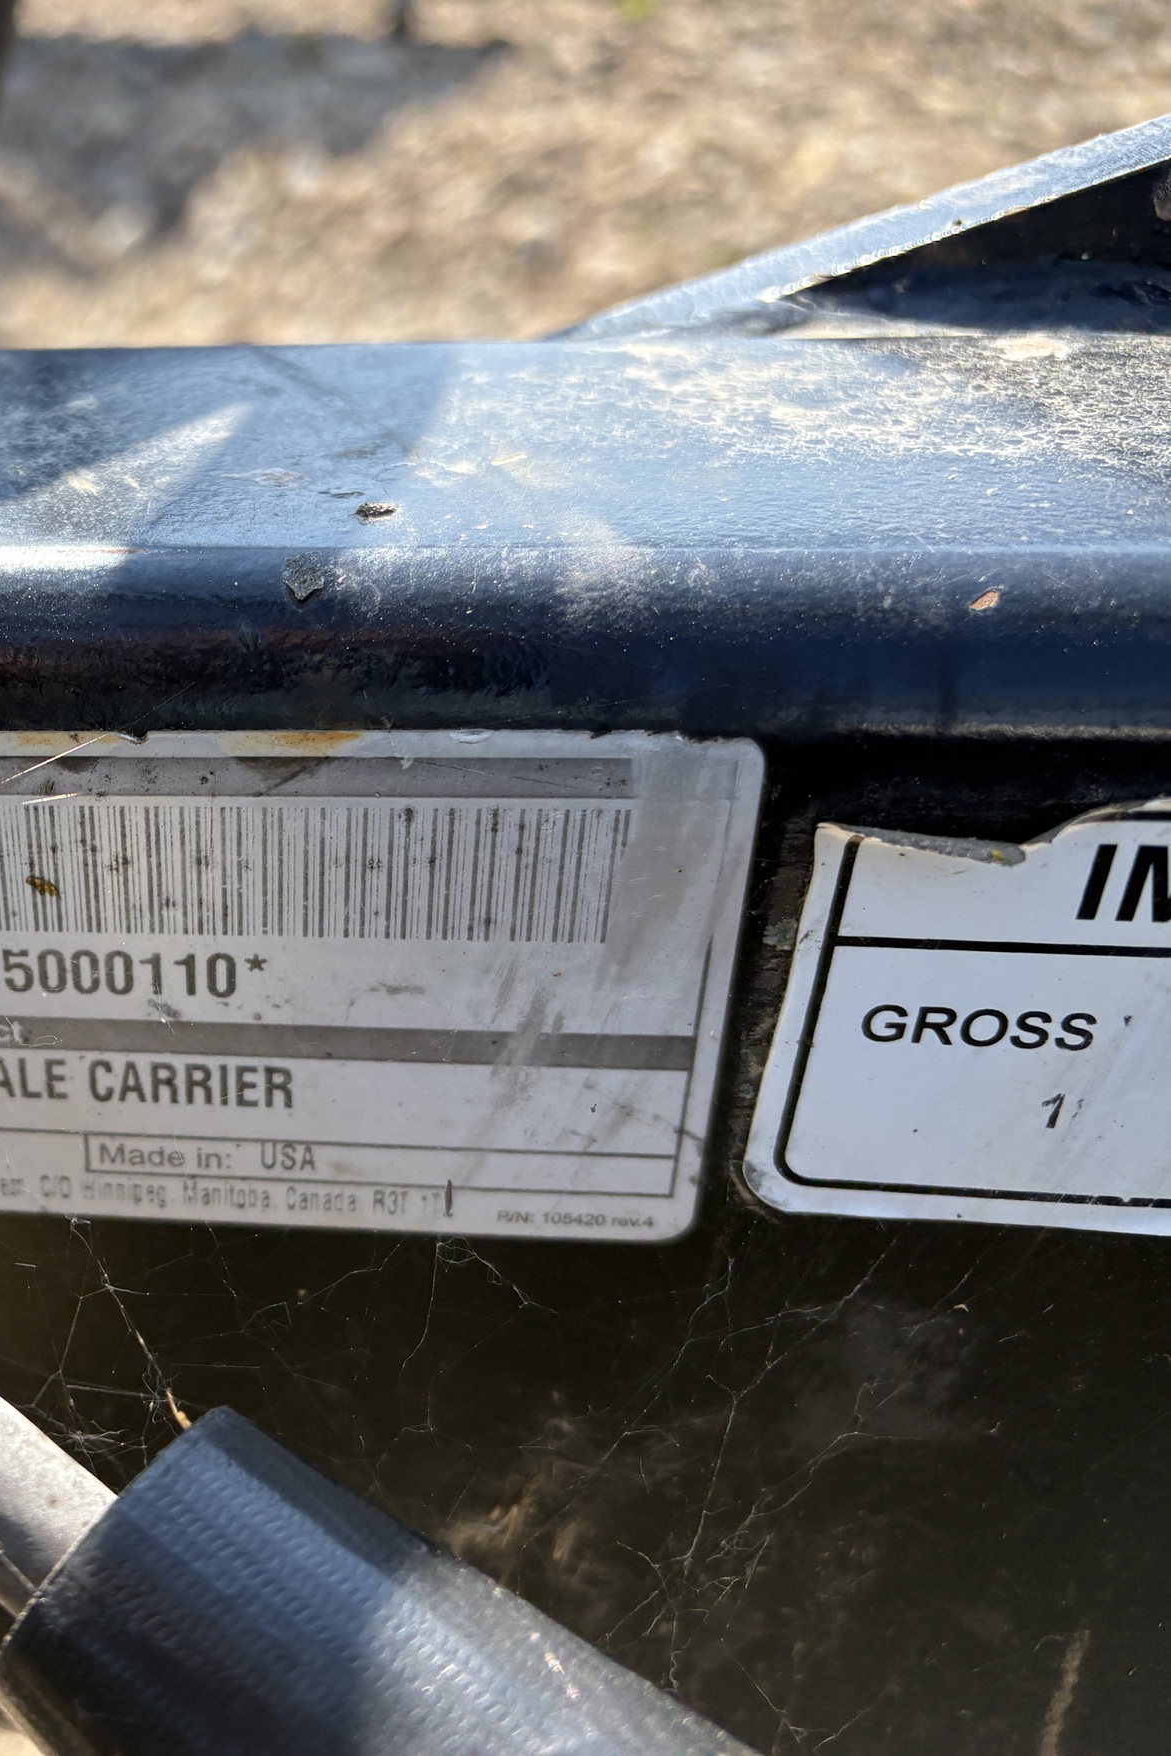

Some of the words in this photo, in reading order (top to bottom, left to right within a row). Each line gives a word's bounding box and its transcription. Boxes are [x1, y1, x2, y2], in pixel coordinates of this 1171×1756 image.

[861, 1005, 1097, 1051] GROSS
[87, 1060, 293, 1109] CARRIER
[99, 1142, 185, 1167] Made
[196, 1146, 232, 1170] in:
[259, 1142, 316, 1170] USA
[541, 1211, 606, 1227] 105420
